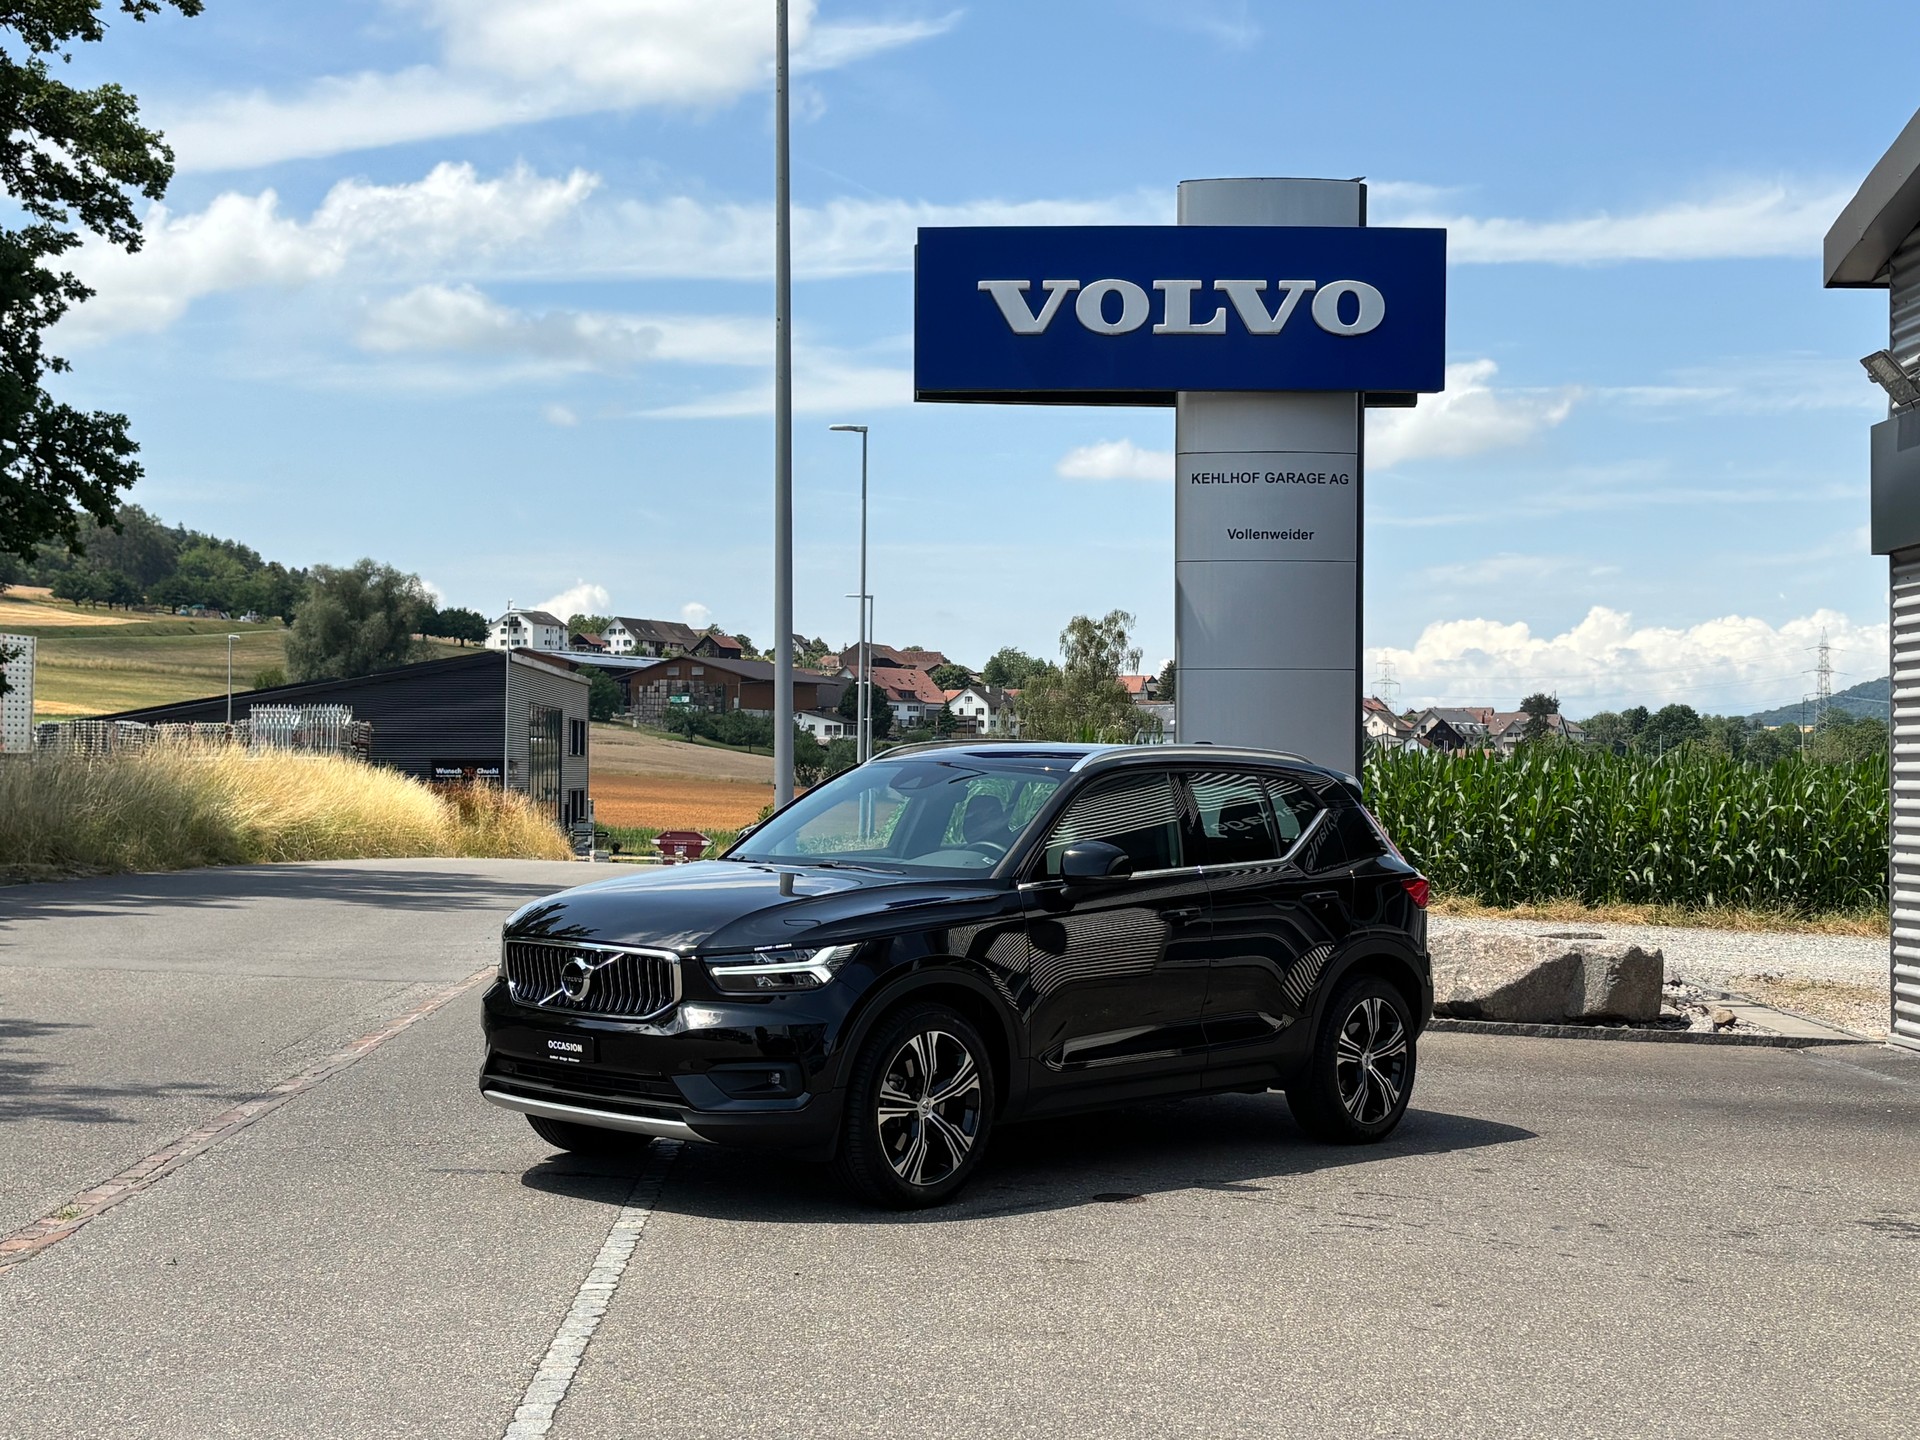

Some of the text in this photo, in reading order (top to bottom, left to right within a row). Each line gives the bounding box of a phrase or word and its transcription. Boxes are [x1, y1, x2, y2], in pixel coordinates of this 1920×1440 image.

[977, 278, 1386, 336] VOLVO
[1191, 472, 1349, 485] KEHLHOF GARAGE AG
[1227, 528, 1315, 540] Vollenweider
[435, 767, 499, 775] Wunsch Chuchi
[547, 1039, 583, 1053] OCCASION
